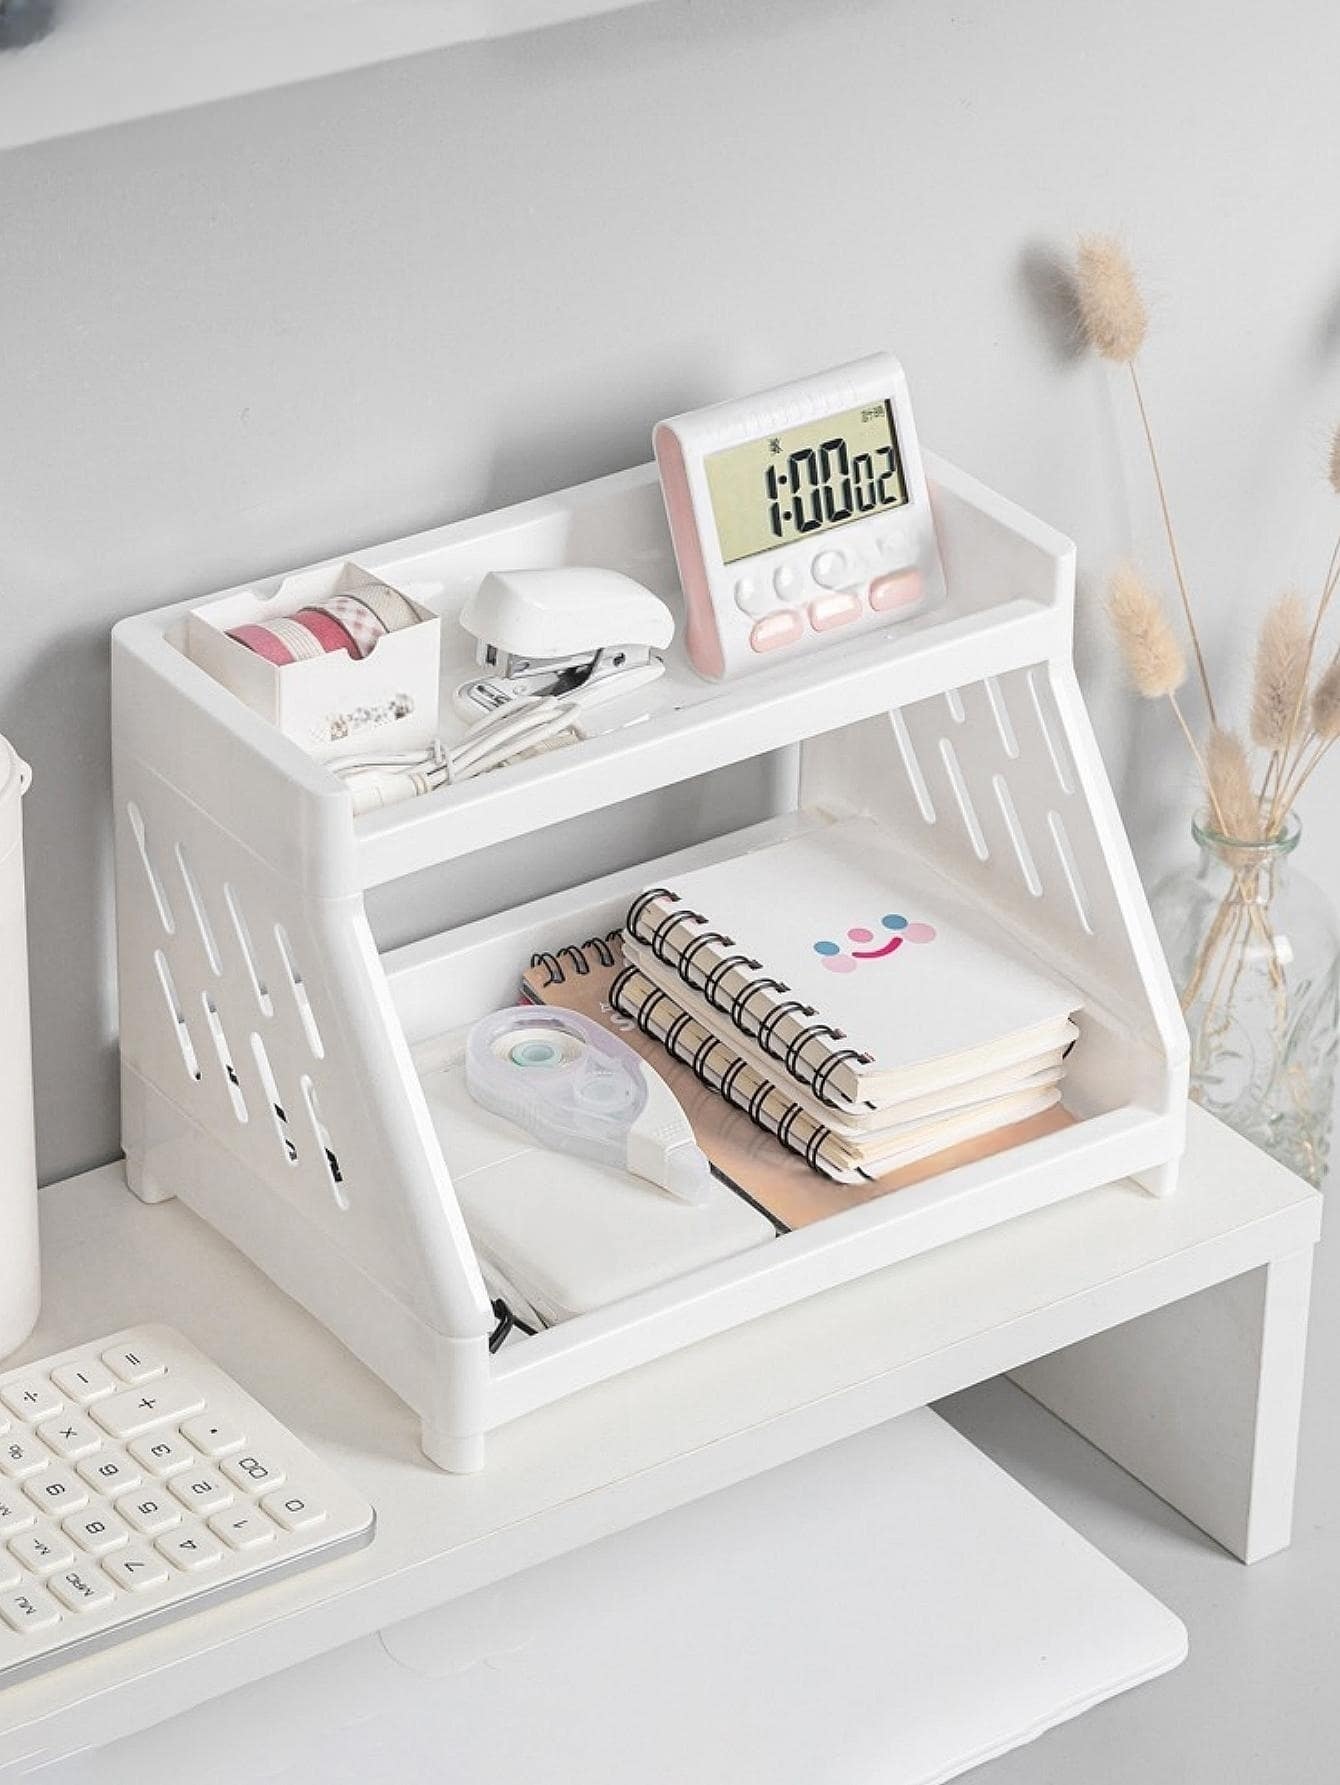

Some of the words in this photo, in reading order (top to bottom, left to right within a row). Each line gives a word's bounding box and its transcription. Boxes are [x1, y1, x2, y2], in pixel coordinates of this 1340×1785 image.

[150, 1443, 172, 1458] 3
[98, 1463, 120, 1477] 6
[238, 1456, 269, 1480] 00
[45, 1483, 66, 1496] 9
[190, 1480, 213, 1494] 2
[137, 1501, 159, 1515] 5
[284, 1498, 305, 1513] 0
[85, 1521, 106, 1535] 8
[232, 1519, 249, 1529] 1
[179, 1539, 198, 1550] 4
[123, 1562, 145, 1573] 7
